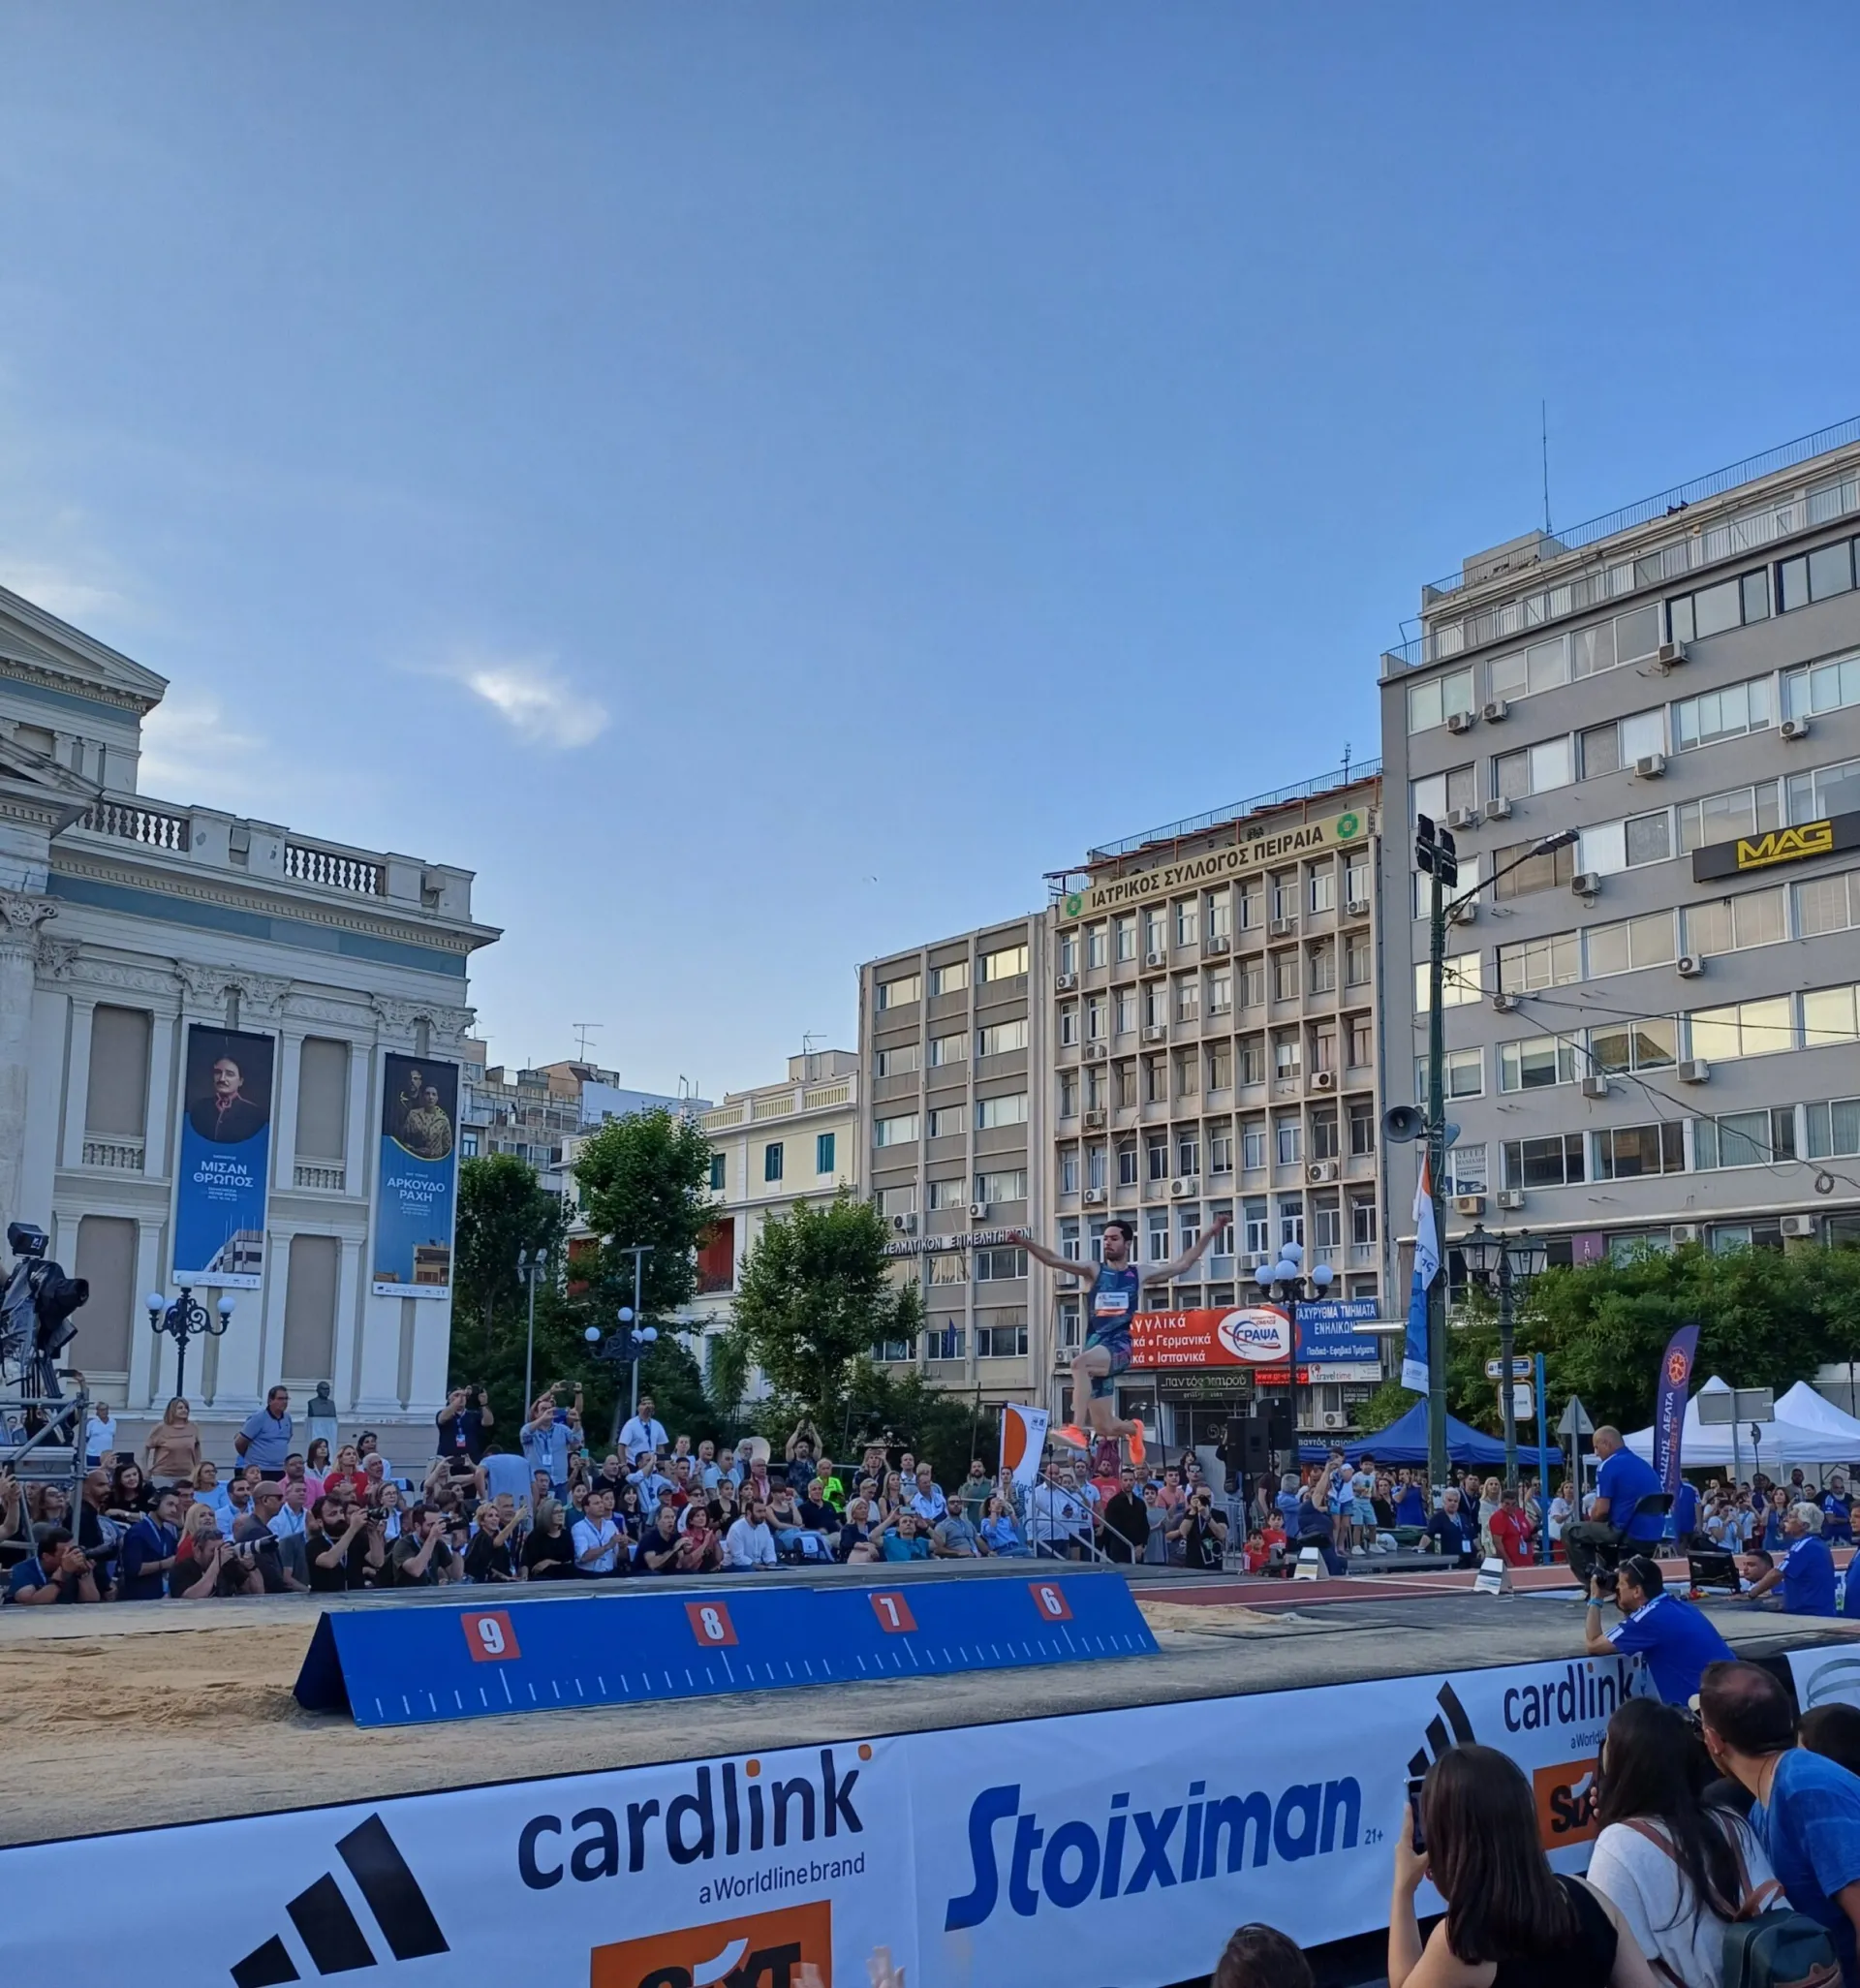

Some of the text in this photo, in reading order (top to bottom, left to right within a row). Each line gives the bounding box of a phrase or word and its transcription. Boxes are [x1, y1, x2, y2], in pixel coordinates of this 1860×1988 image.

[1737, 821, 1832, 862] MAG
[1092, 825, 1323, 909] ΙΑΤΡΙΚΟΣ ΣΥΛΛΟΓΟΣ ΠΕΙΡΑΙΑ
[201, 1161, 247, 1175] ΜΙΣΑΝ
[193, 1172, 254, 1188] ΘΡΩΠΟΣ
[387, 1177, 446, 1193] ΑΡΚΟΥΔΟ
[399, 1190, 433, 1202] ΡΑΧΗ
[1341, 1303, 1376, 1319] ΤΜΗΜΑΤΑ
[1156, 1332, 1211, 1349] Γερμανικά
[1236, 1328, 1280, 1342] ΓΡΑΨΑ
[1157, 1350, 1206, 1363] Ισπανικά
[1662, 1391, 1674, 1433] ΔΕΛΤΑ
[478, 1587, 1063, 1654] 9 8 7 6
[1504, 1658, 1634, 1732] cardlink
[518, 1748, 863, 1890] cardlink
[944, 1775, 1383, 1932] Stoiximan 21+
